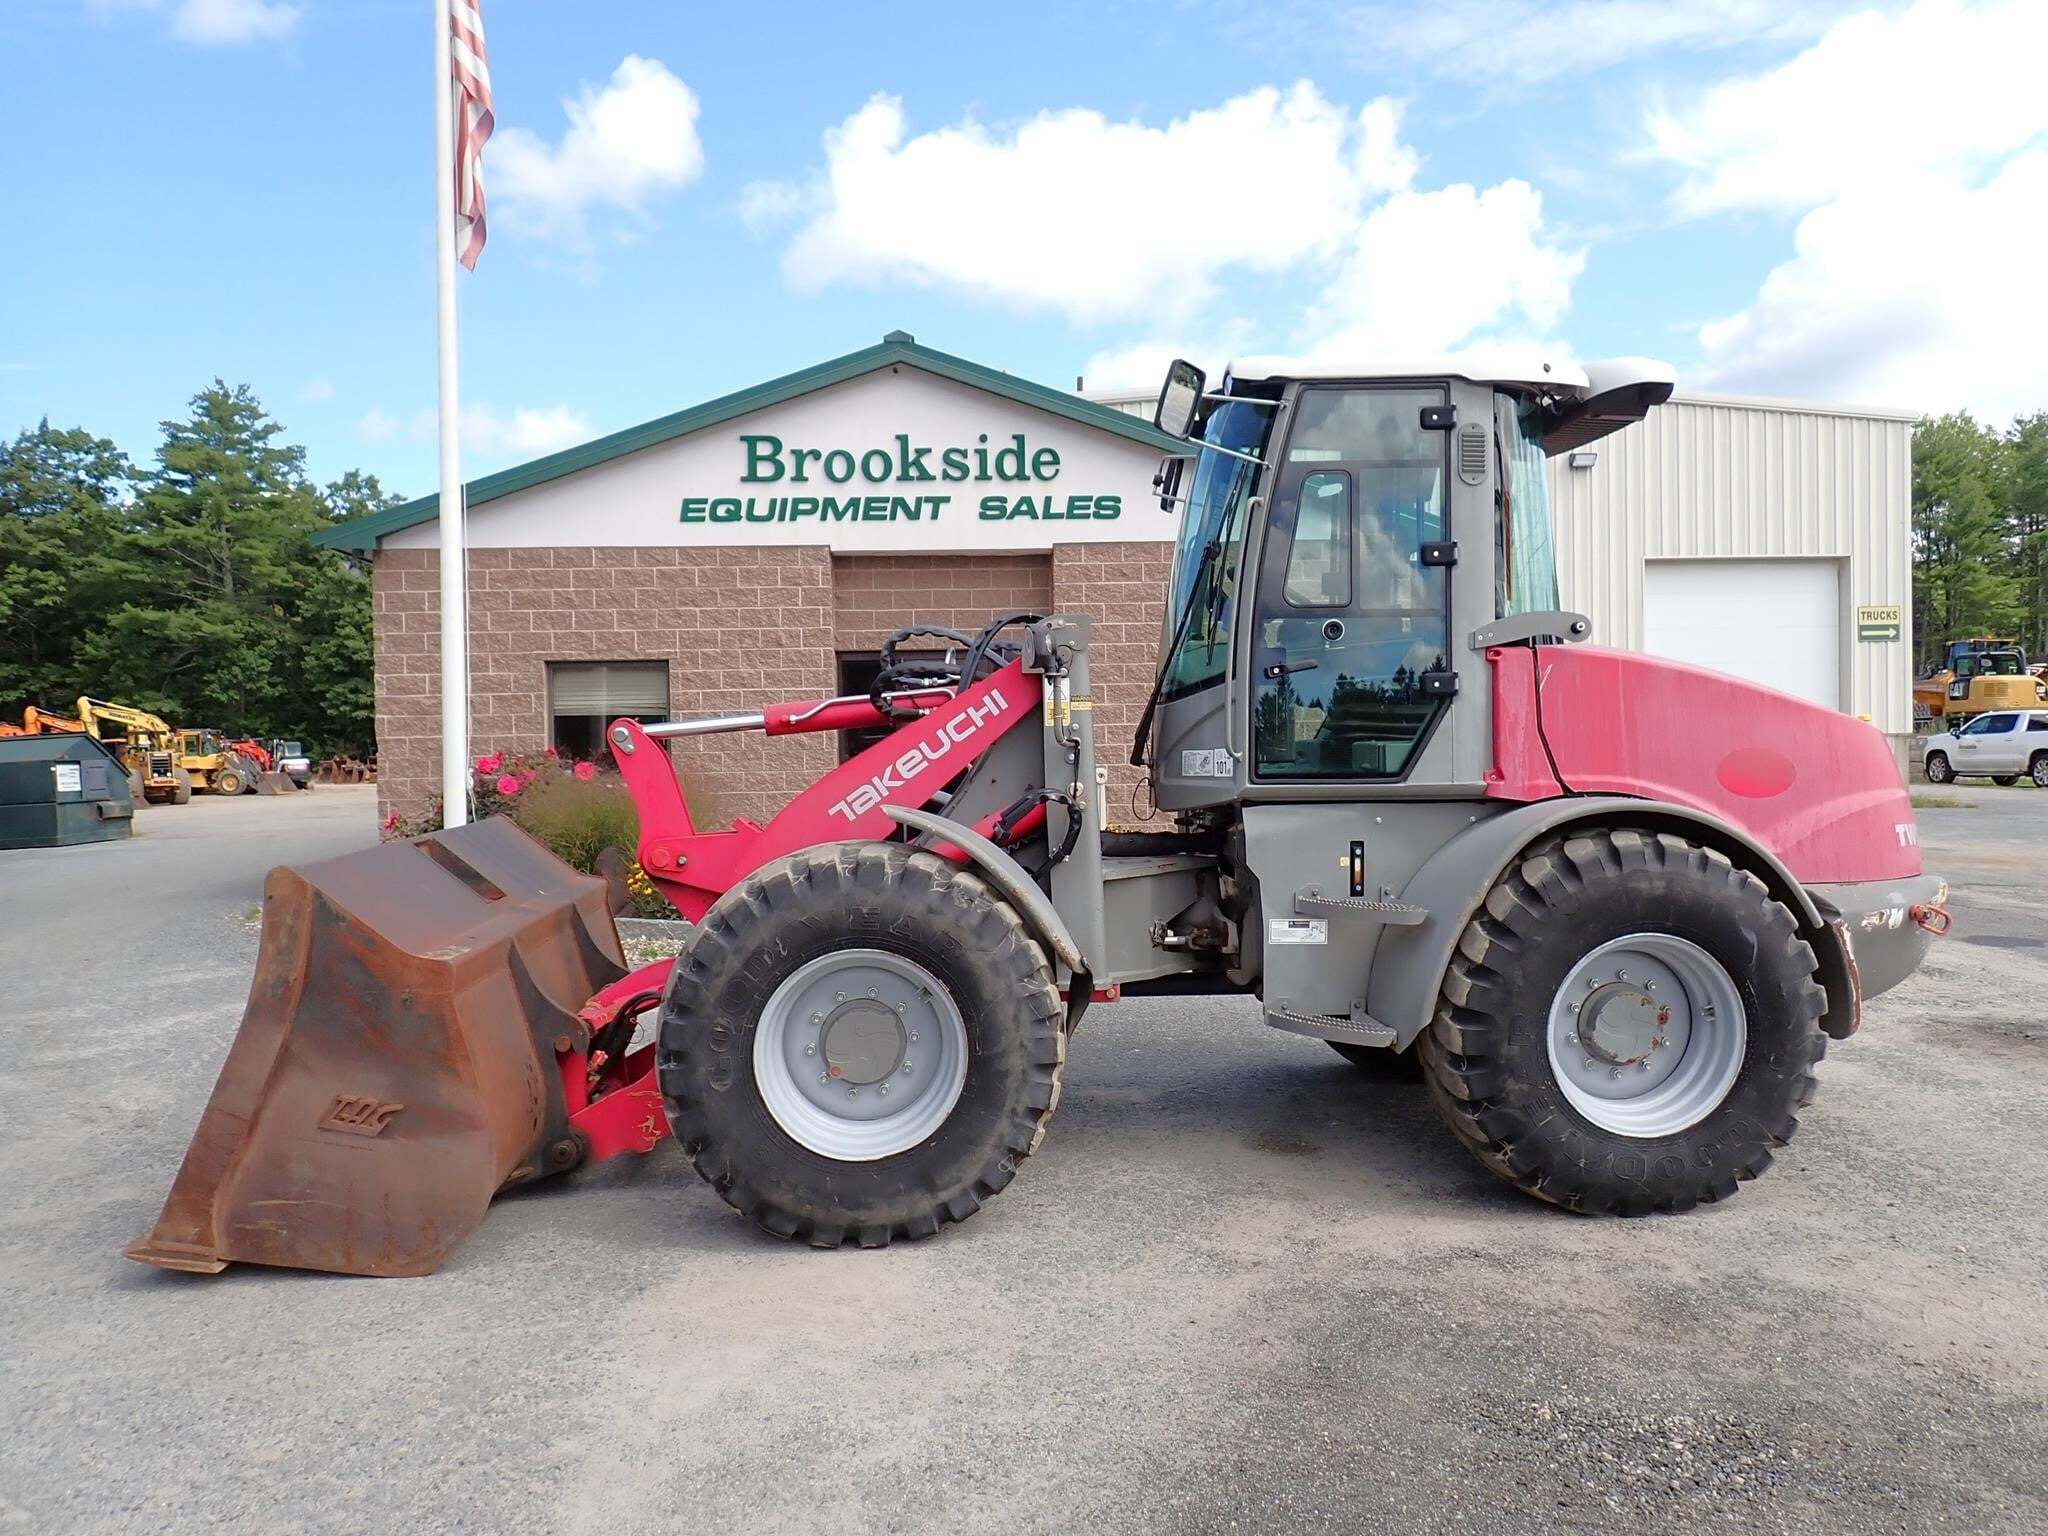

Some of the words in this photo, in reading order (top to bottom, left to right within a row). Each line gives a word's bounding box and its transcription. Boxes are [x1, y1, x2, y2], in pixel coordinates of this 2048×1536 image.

[740, 434, 1061, 483] Brookside
[680, 496, 951, 522] EQUIPMENT
[978, 495, 1122, 521] SALES
[1860, 610, 1898, 621] TRUCKS
[1216, 760, 1227, 774] 101
